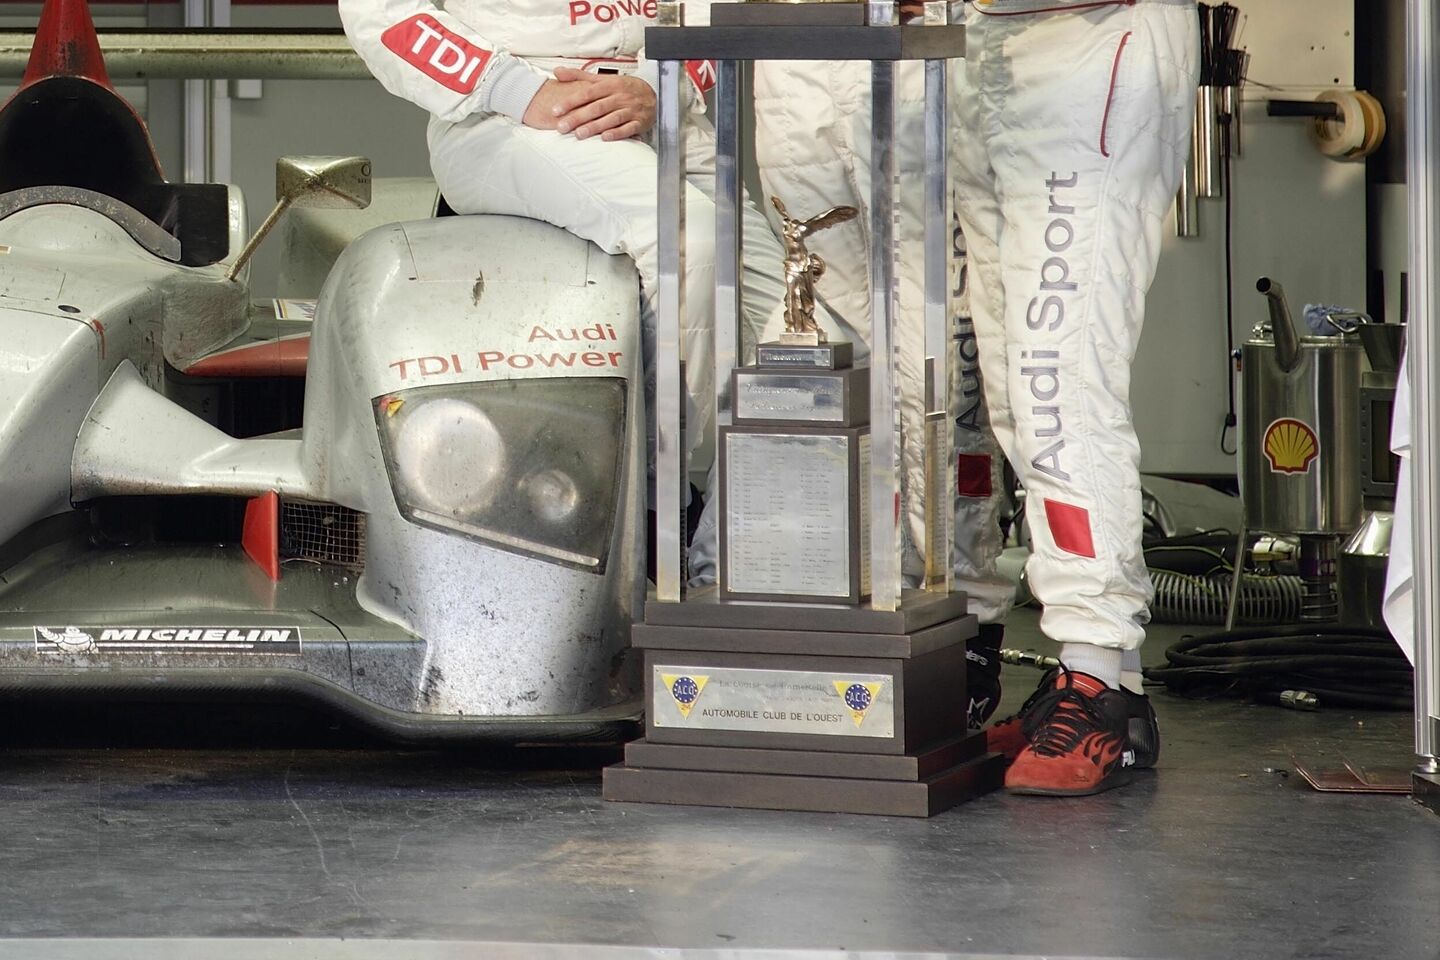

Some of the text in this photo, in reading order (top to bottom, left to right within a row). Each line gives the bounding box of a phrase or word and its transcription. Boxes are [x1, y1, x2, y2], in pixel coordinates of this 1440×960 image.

[569, 0, 658, 26] Powe
[409, 19, 482, 84] TDI
[528, 323, 618, 343] Audi
[1021, 171, 1078, 482] Audi Sport
[388, 351, 623, 380] TDI Power
[99, 629, 291, 642] MICHELIN
[702, 708, 844, 723] AUTOMOBILE CLUB DE L'OUEST
